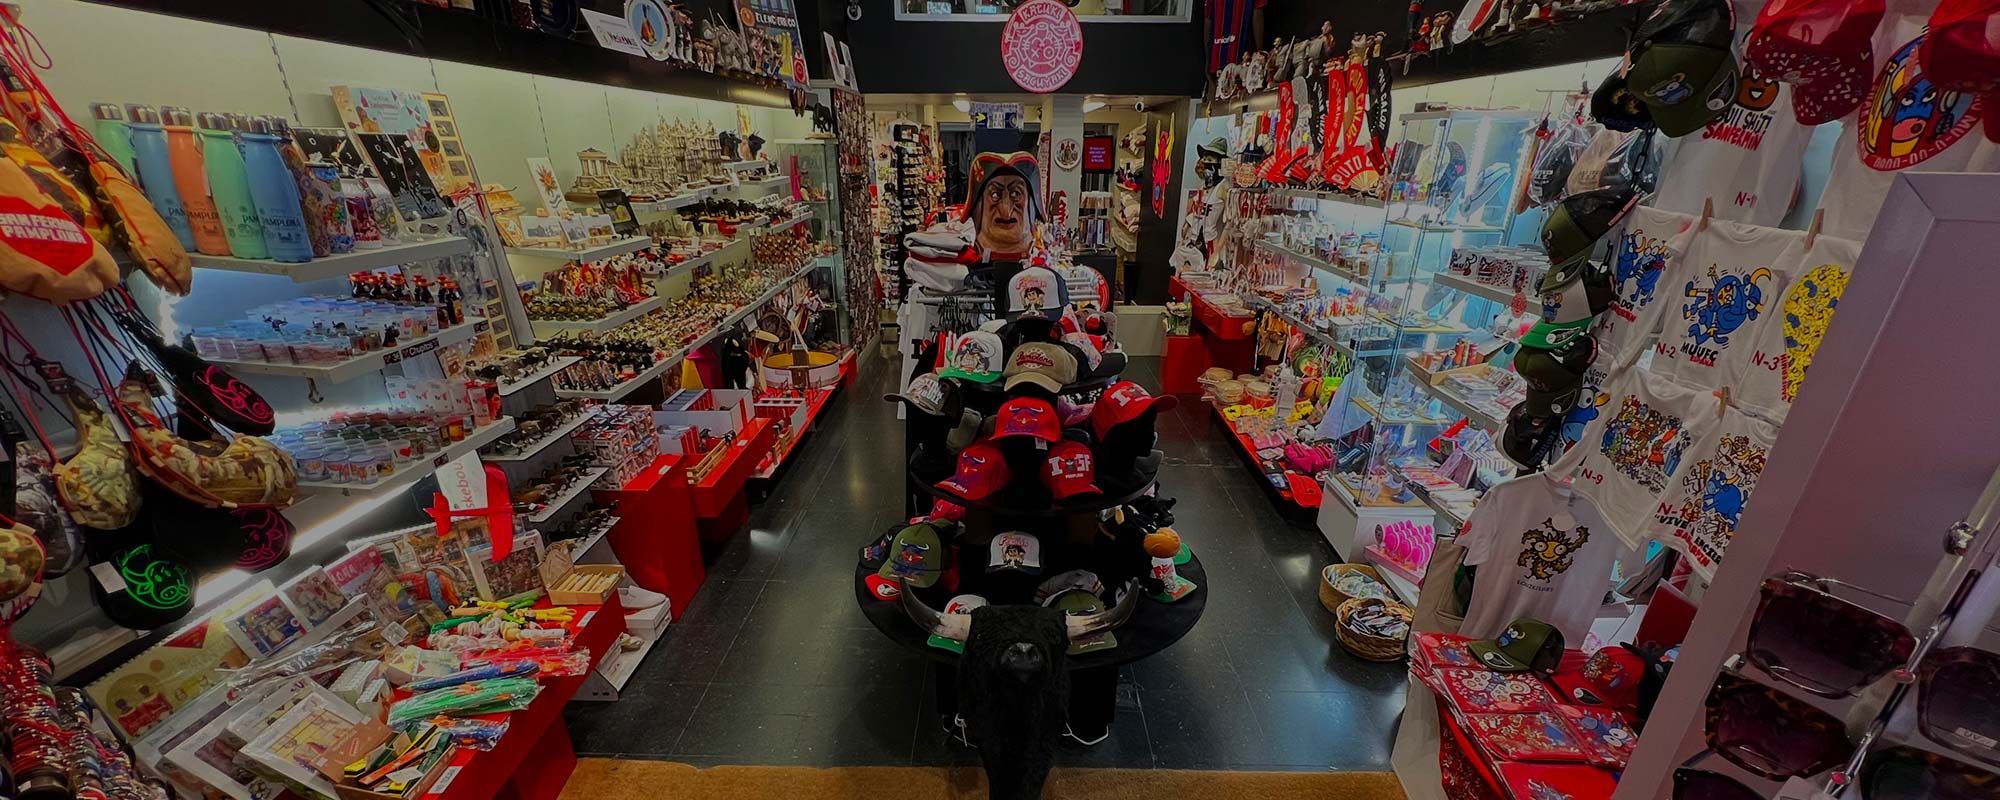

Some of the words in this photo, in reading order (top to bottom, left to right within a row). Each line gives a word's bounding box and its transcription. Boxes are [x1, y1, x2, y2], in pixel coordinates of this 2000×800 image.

[1655, 342, 1676, 359] N-2
[1752, 350, 1779, 371] N-3
[1581, 467, 1604, 485] N-9
